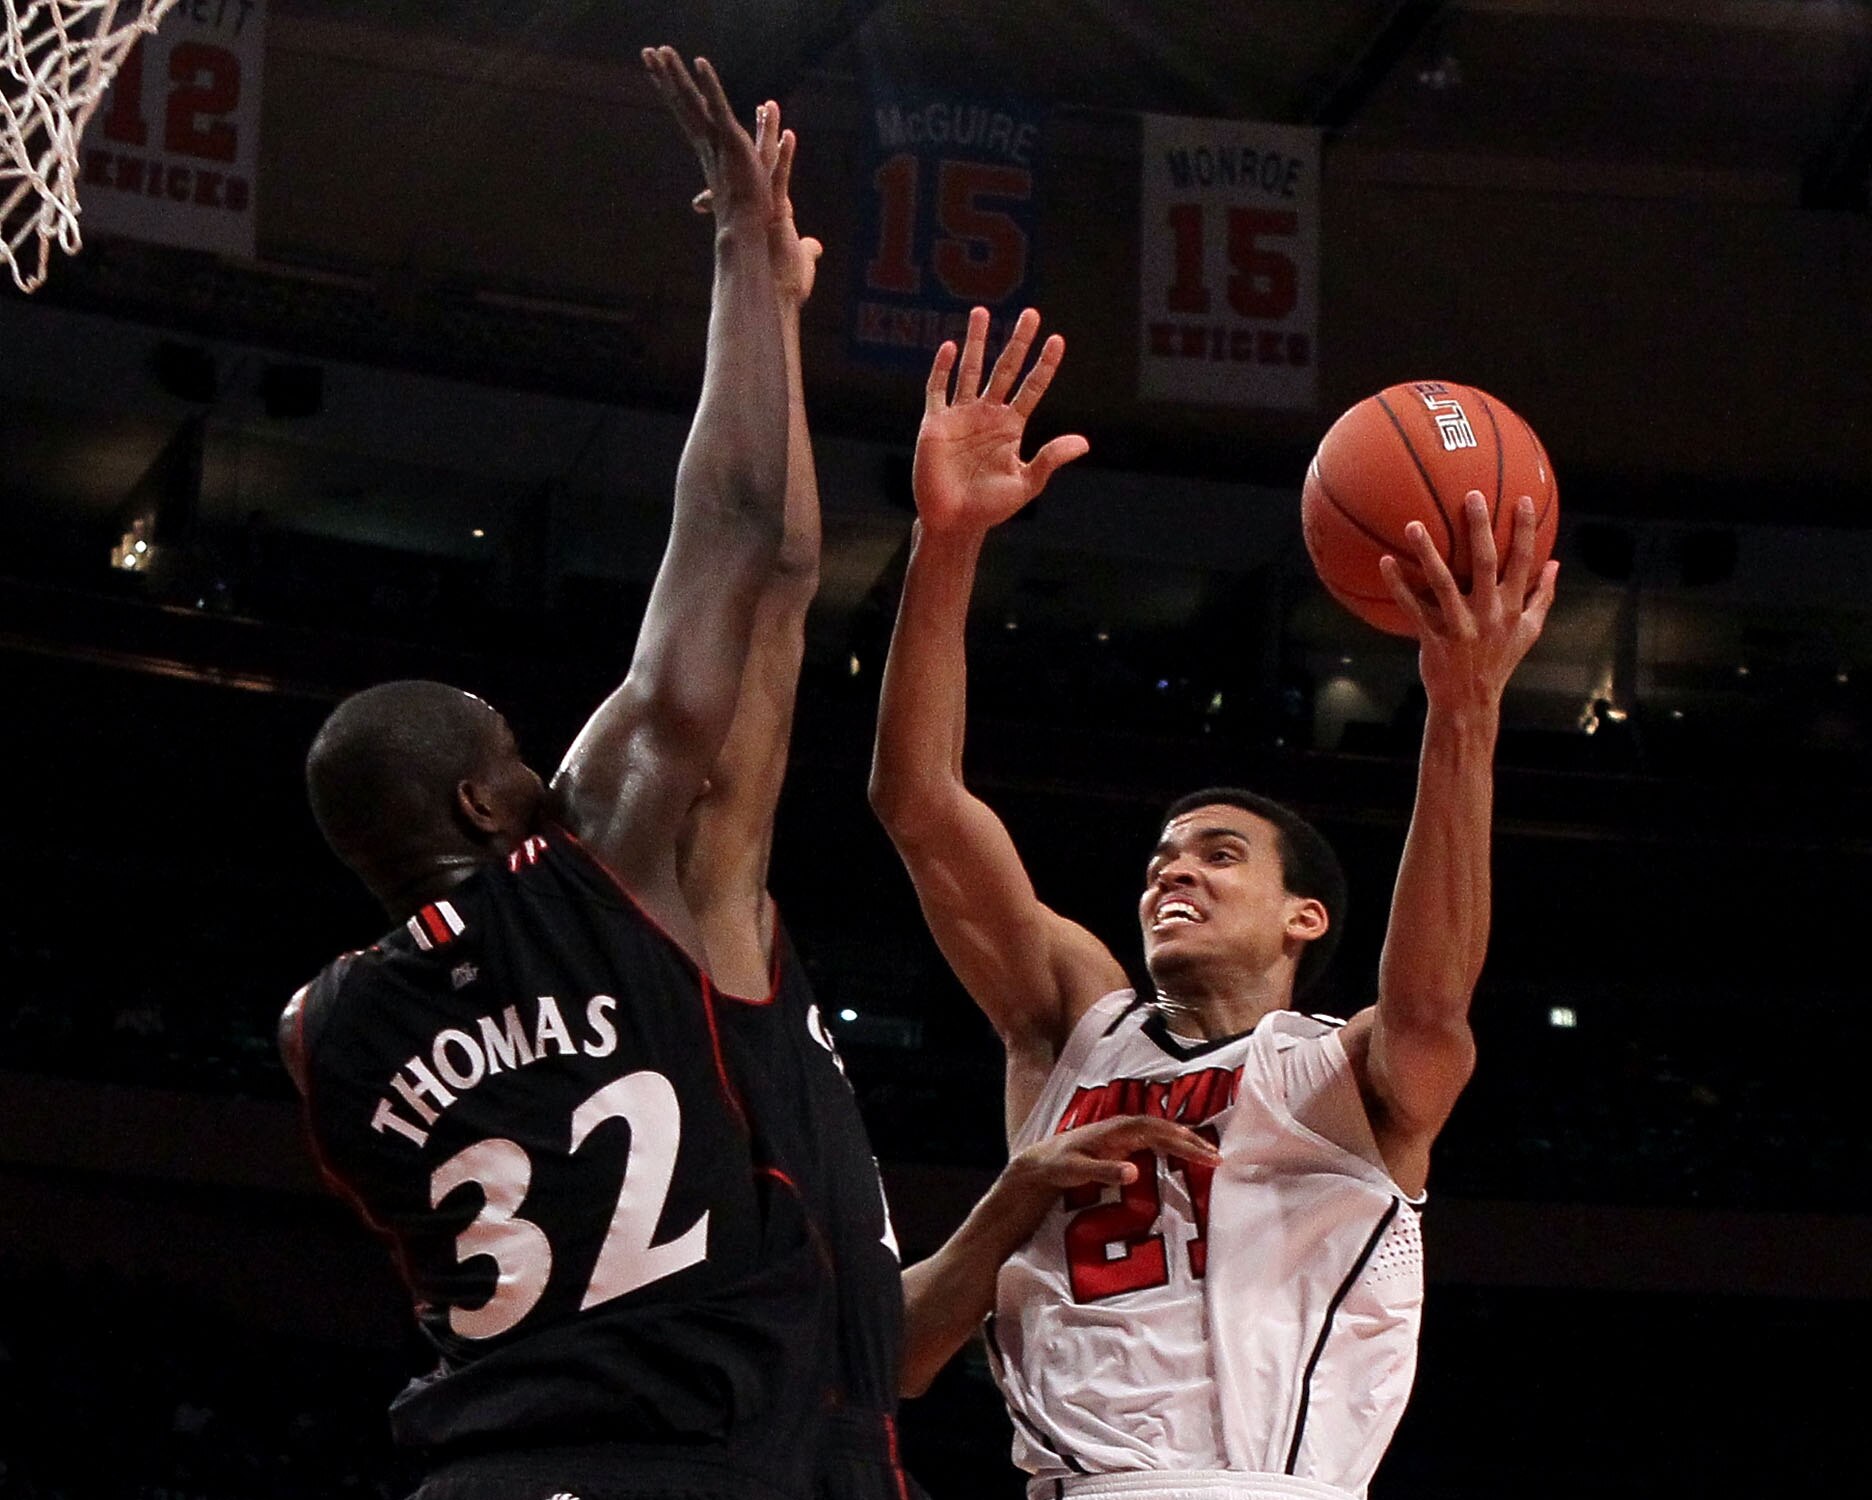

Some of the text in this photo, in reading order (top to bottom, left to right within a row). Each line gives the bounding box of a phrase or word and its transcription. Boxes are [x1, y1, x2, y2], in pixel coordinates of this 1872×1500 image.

[866, 151, 1034, 303] 15
[1167, 202, 1299, 320] 15
[370, 994, 619, 1149] THOMAS
[428, 1069, 711, 1341] 32
